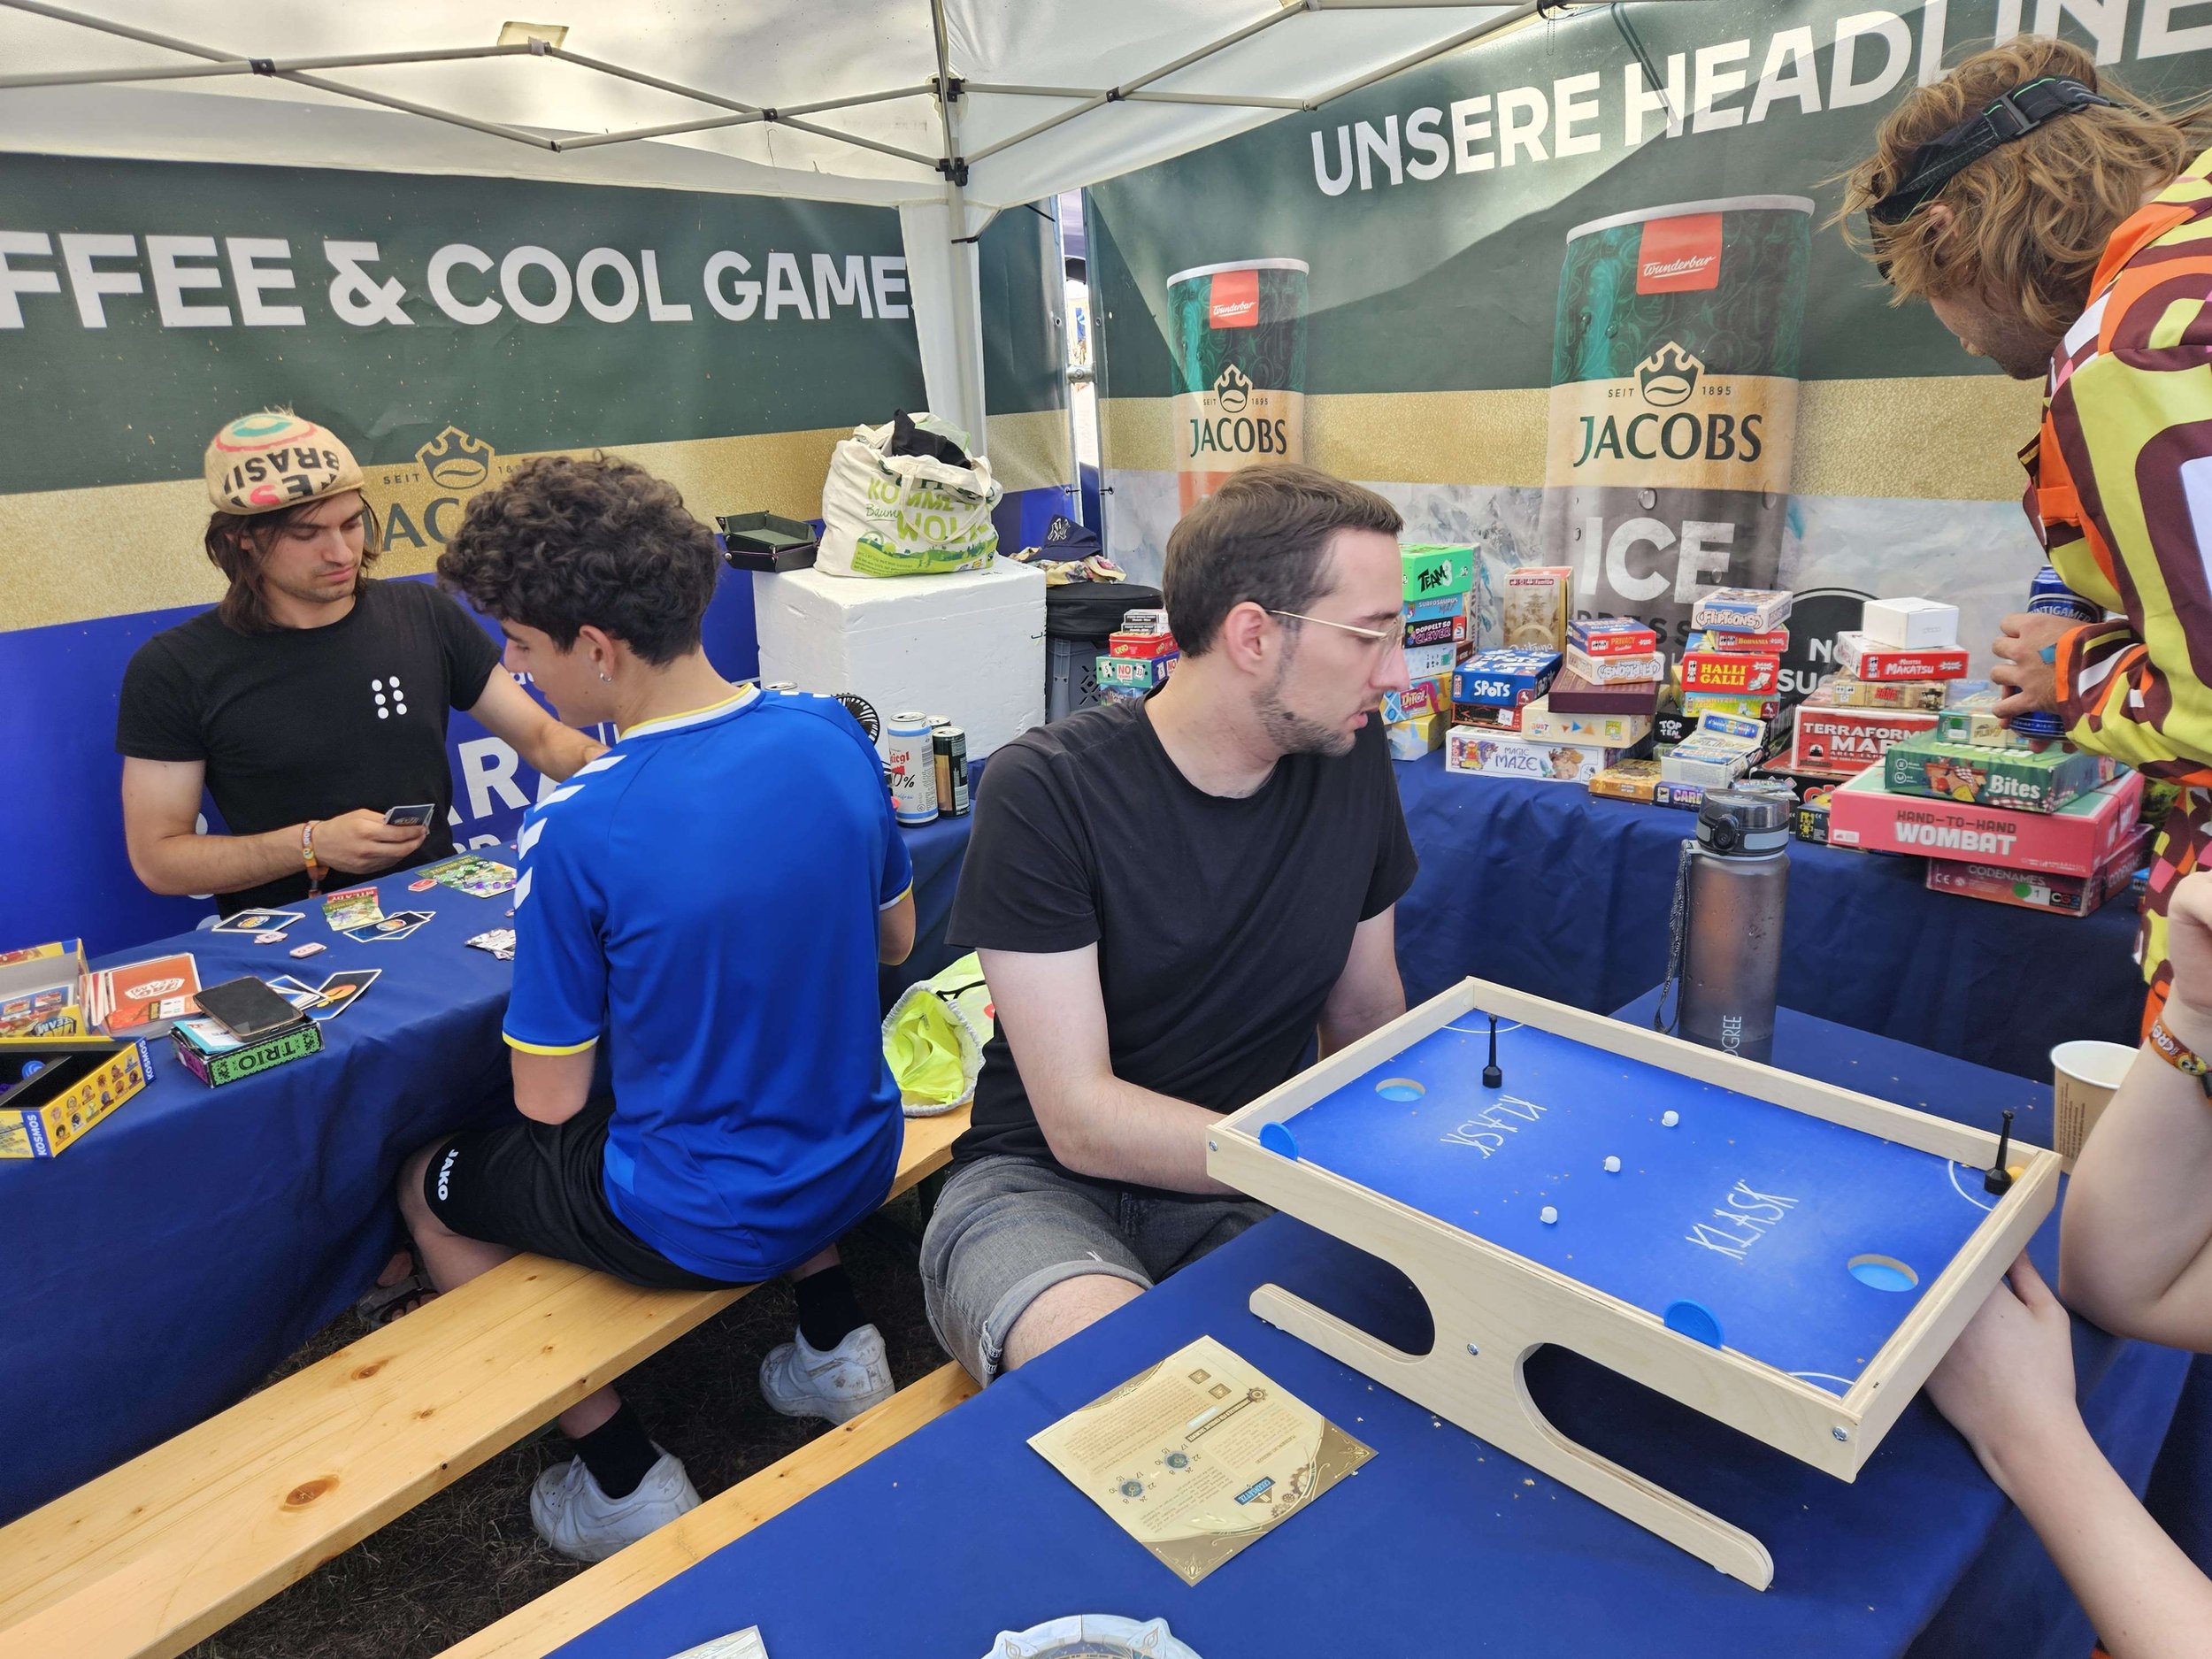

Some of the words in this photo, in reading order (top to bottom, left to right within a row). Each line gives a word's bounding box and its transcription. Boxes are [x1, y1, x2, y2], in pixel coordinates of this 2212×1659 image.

[1310, 71, 1601, 196] UNSERE
[323, 241, 416, 326] &
[426, 242, 694, 325] COOL
[703, 250, 914, 322] GAME
[1251, 397, 1269, 406] 1895
[1608, 388, 1635, 398] SEIT
[1701, 385, 1732, 396] 1895
[1189, 417, 1287, 457] JACOBS
[1573, 412, 1763, 468] JACOBS
[383, 472, 420, 485] SEIT
[1579, 516, 1736, 603] ICE
[1416, 622, 1441, 634] DOPPELT
[1416, 627, 1451, 644] CLEVER
[1118, 664, 1132, 675] NO
[1700, 674, 1746, 685] GALLI
[1701, 664, 1747, 674] HALLI
[1659, 720, 1683, 730] TOP
[1495, 754, 1538, 771] MAZE
[1504, 747, 1529, 756] MAGIC
[1991, 775, 2041, 799] Bites
[1896, 810, 2017, 834] HAND-TO-HAND
[1894, 821, 2017, 856] WOMBAT
[1969, 864, 2047, 887] CODENAMES
[139, 1040, 154, 1081] KOSMOS
[238, 1041, 293, 1071] TRIO
[27, 1114, 48, 1156] KOSMOS
[1440, 1094, 1548, 1158] KLASK
[438, 1148, 459, 1201] JAKO
[1686, 1179, 1800, 1261] KLASK
